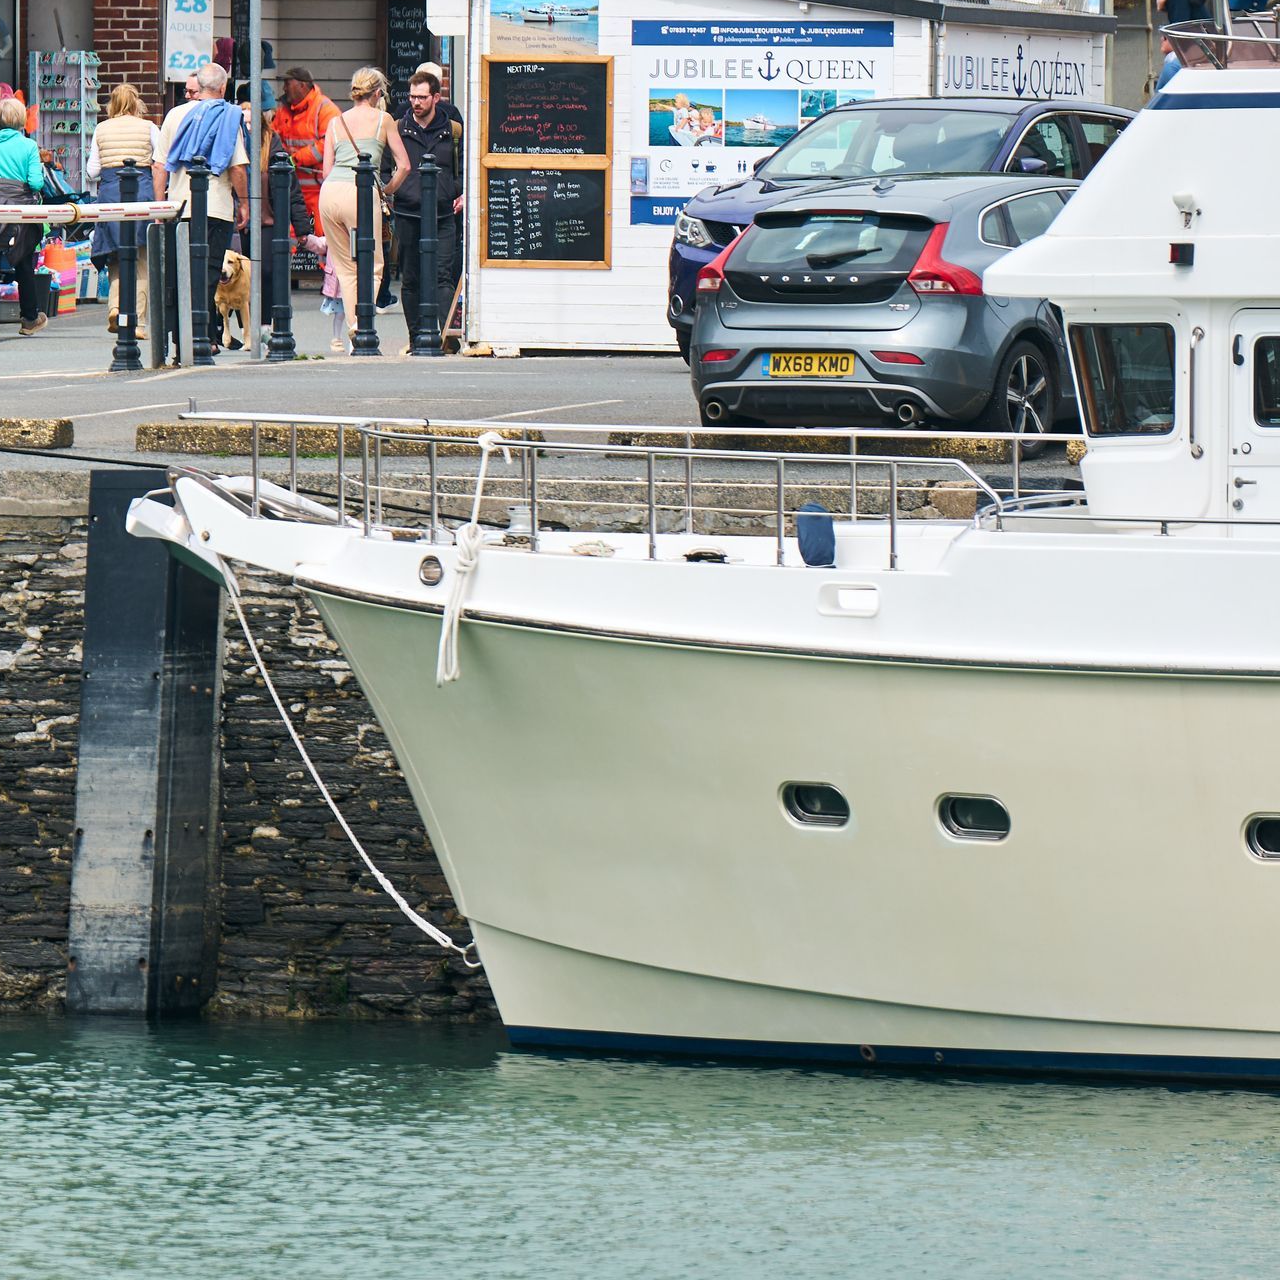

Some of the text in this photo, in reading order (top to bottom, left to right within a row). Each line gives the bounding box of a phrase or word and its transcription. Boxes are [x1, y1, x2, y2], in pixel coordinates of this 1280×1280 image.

[170, 22, 211, 32] ADULTS
[506, 64, 539, 74] NEXT TRIP
[649, 59, 876, 85] JUBILEE QUEEN
[944, 55, 1086, 99] JUBILEE QUEEN
[653, 206, 674, 216] ENJOY
[759, 275, 859, 283] VOLVO
[772, 356, 850, 372] WX68 KMO
